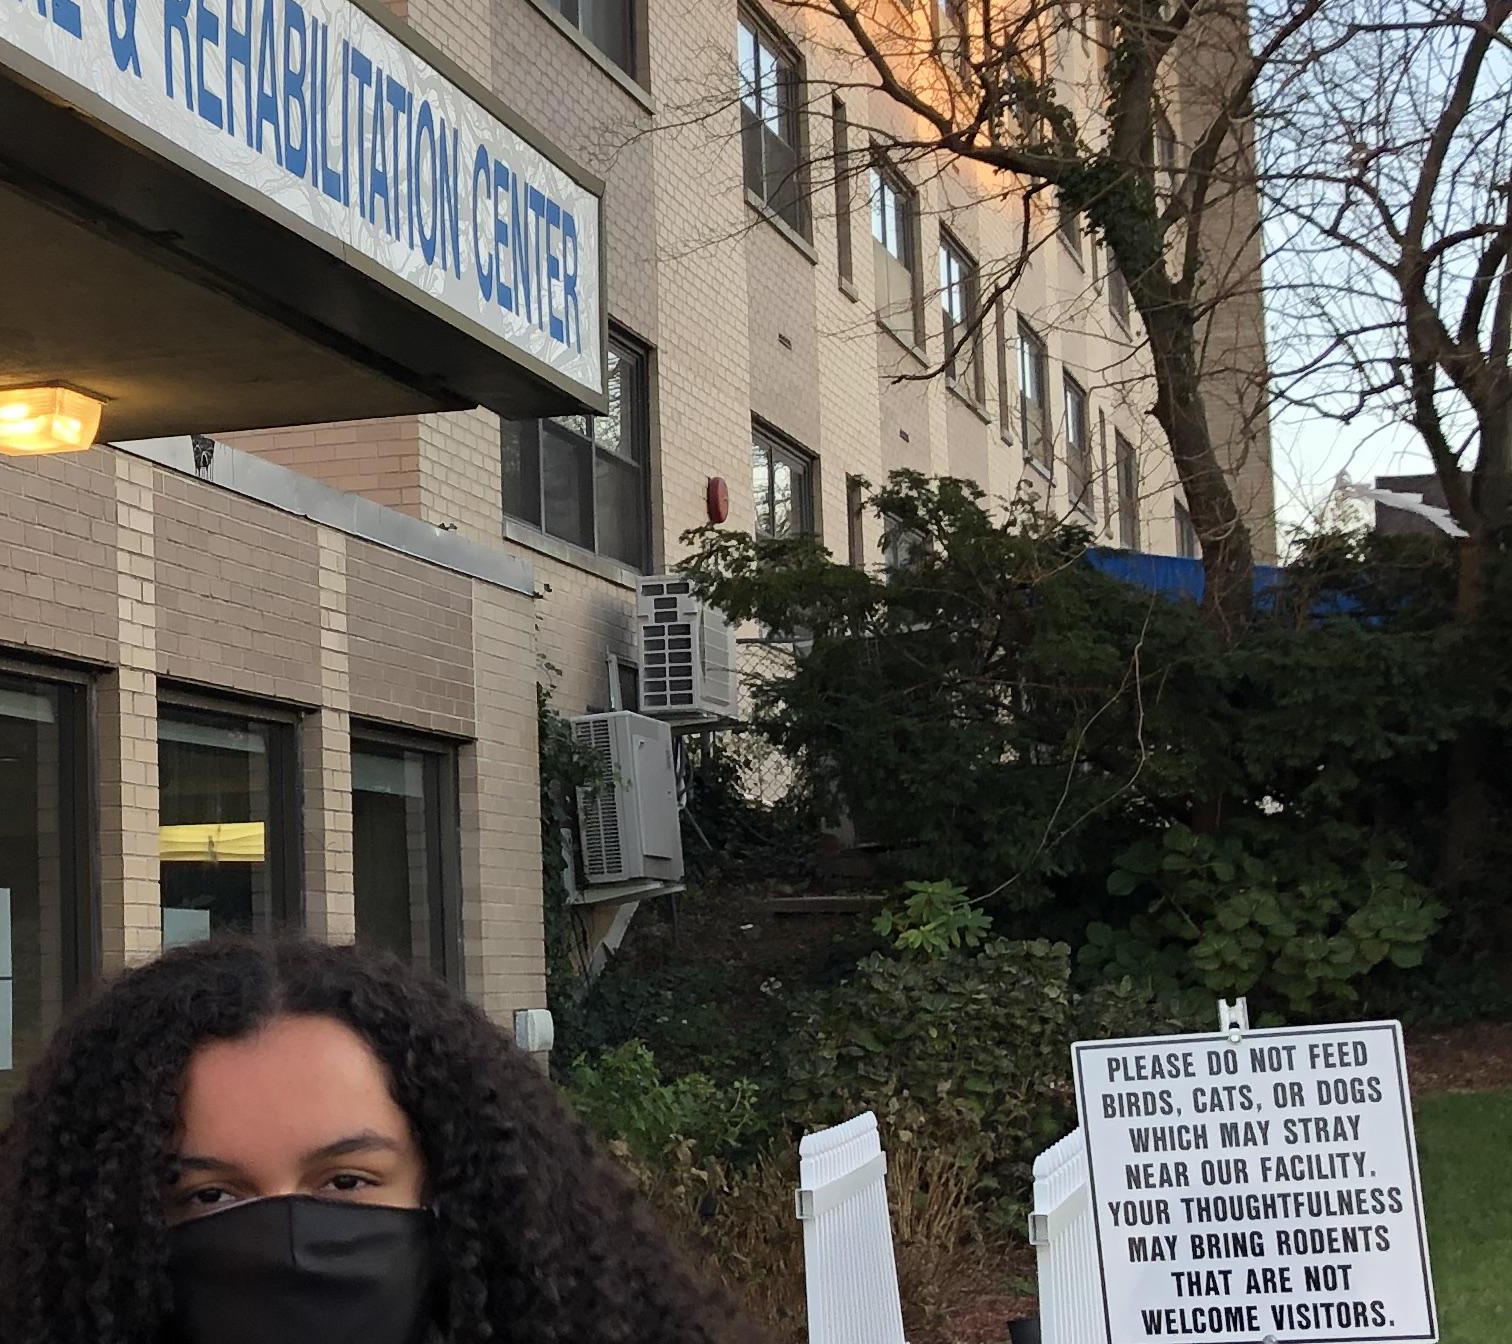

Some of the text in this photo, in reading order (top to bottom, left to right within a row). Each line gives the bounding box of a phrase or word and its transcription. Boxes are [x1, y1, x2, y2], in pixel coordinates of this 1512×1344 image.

[474, 145, 581, 355] CENTER
[1107, 1041, 1368, 1082] PLEASE DO NOT FEED
[1102, 1076, 1383, 1118] BIRDS, CATS, OR DOGS
[1129, 1114, 1361, 1153] WHICH MAY STRAY
[1125, 1152, 1376, 1190] NEAR OUR FACILITY.
[1107, 1187, 1403, 1227] YOUR THOUGHTFULNESS
[1128, 1225, 1390, 1262] MAY BRING RODENTS
[1171, 1264, 1353, 1297] THAT ARE NOT
[1142, 1300, 1394, 1335] WELCOME VISITORS.
